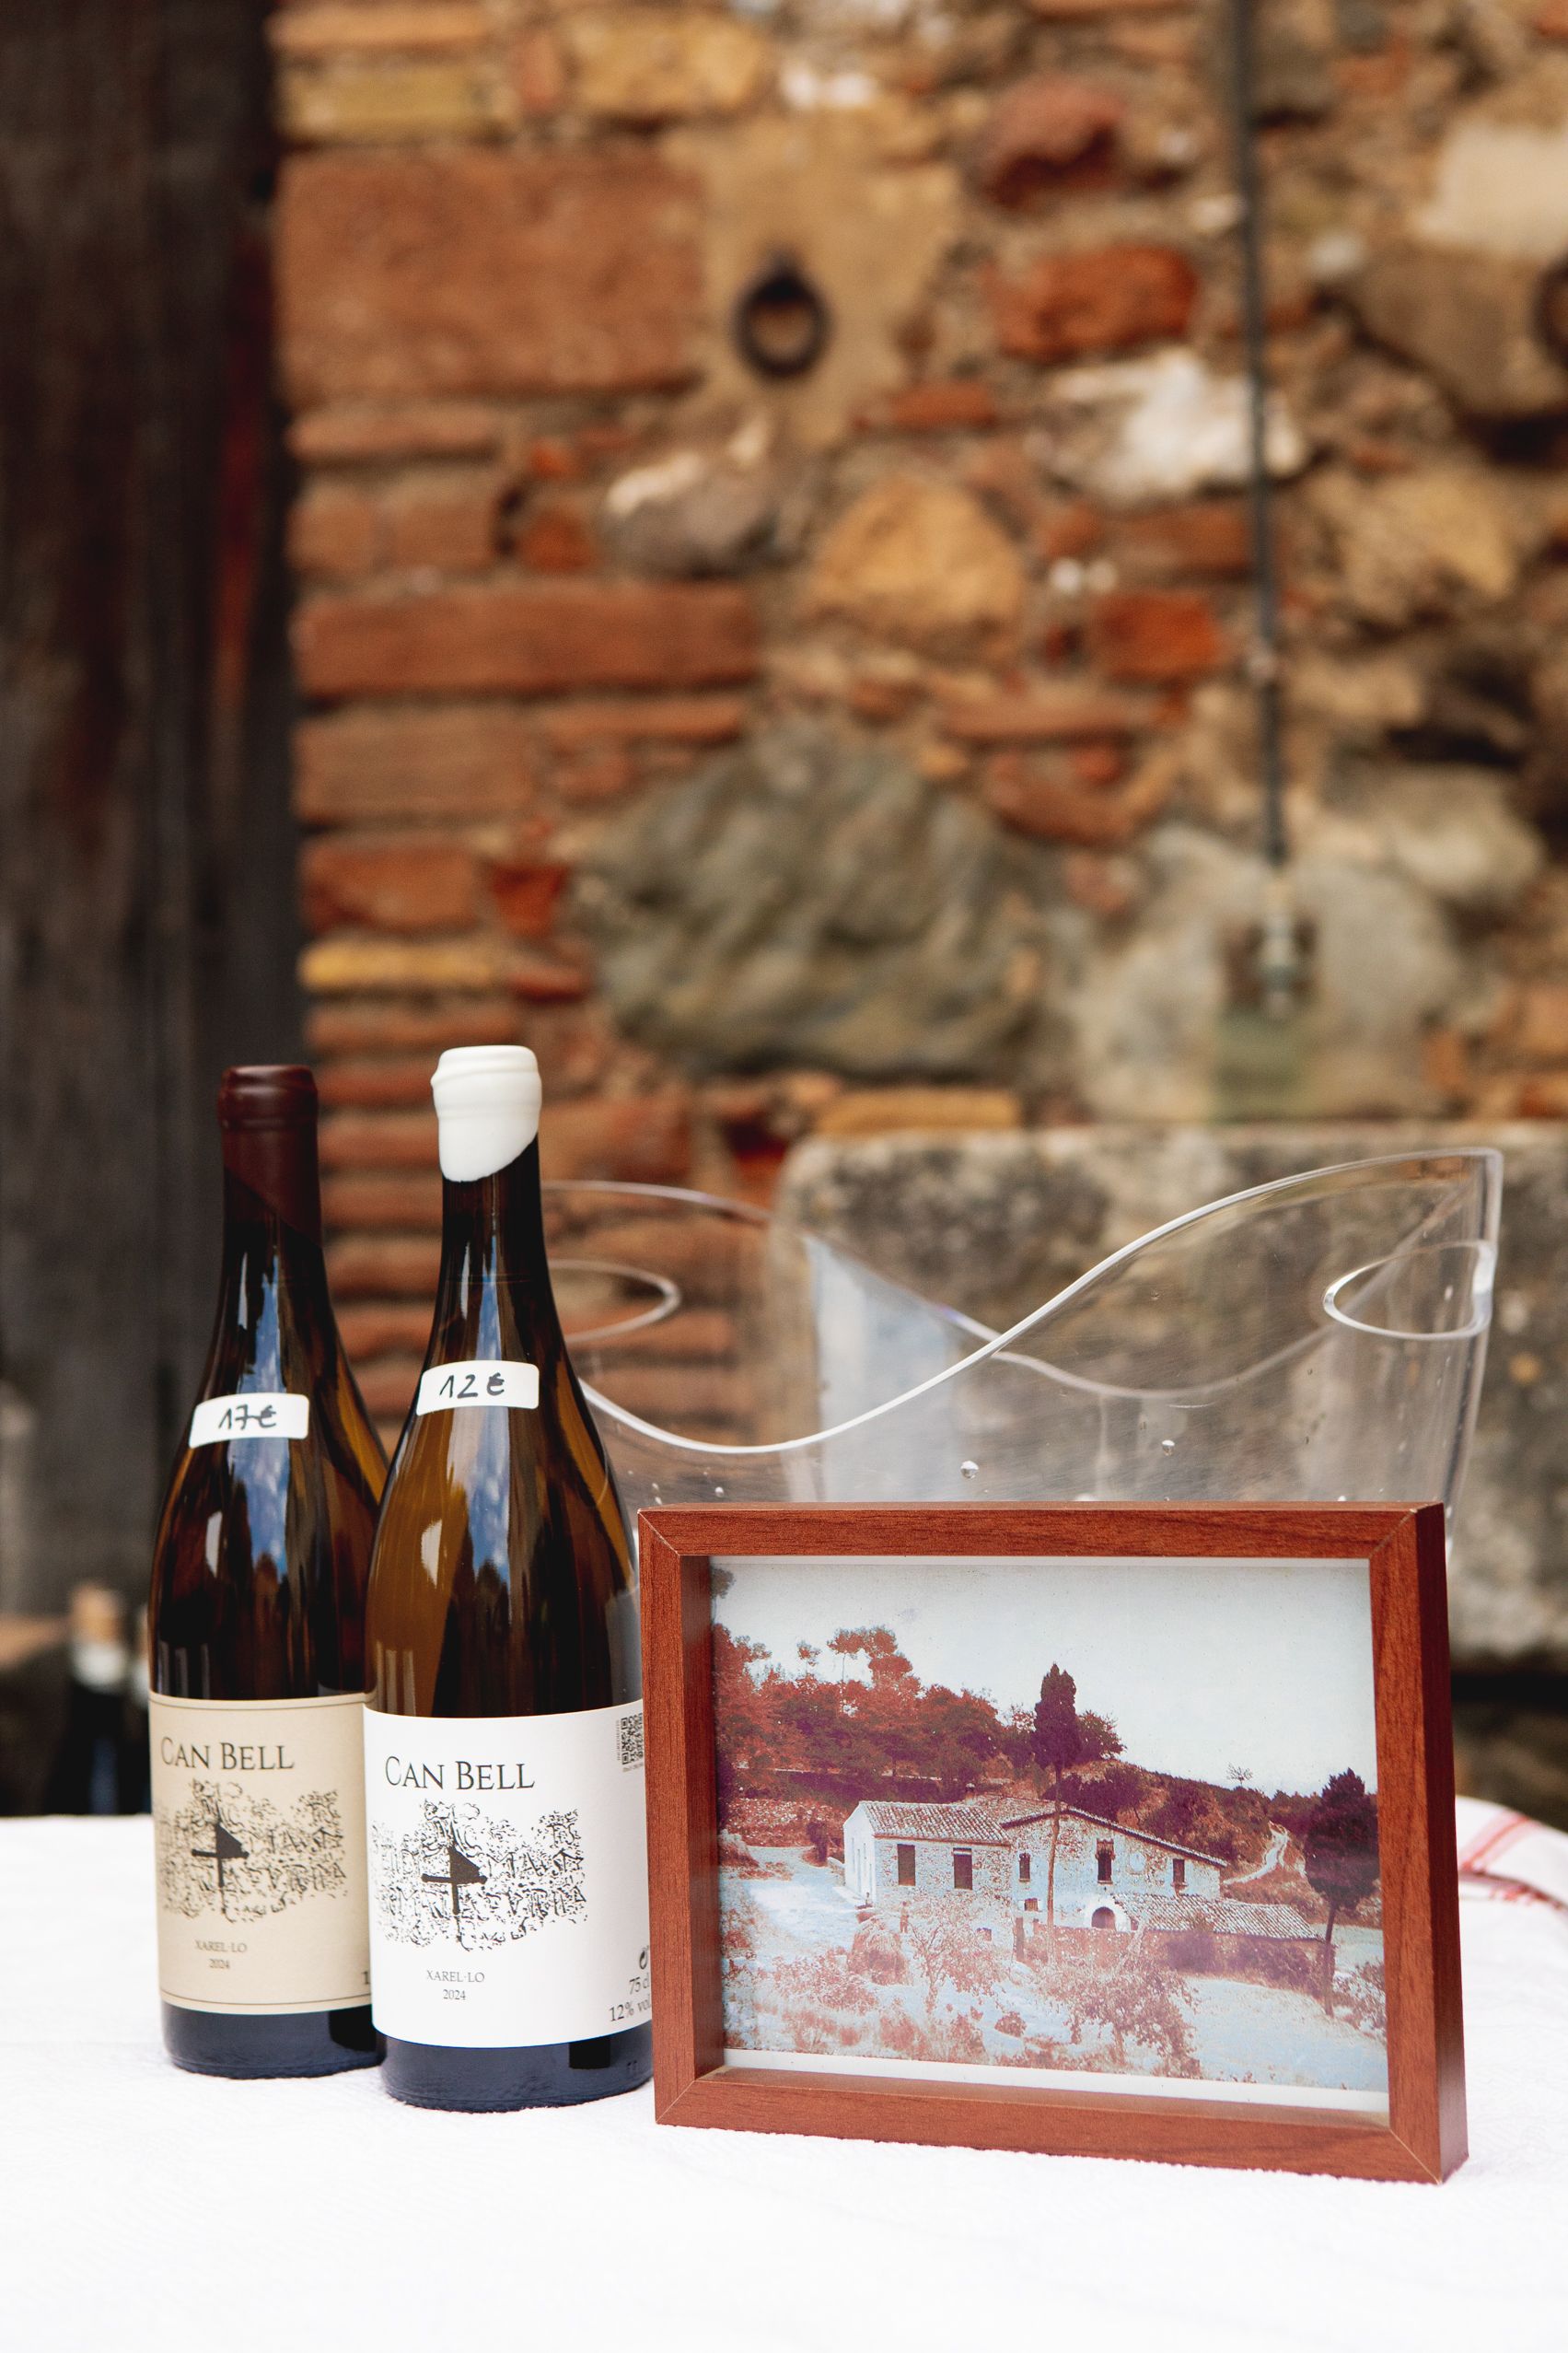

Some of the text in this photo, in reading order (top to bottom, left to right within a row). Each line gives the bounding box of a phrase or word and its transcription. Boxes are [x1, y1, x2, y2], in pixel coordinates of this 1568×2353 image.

[218, 1404, 278, 1430] 17€
[442, 1988, 467, 2000] 2024
[629, 1976, 642, 1995] 75
[609, 2001, 634, 2021] 12%
